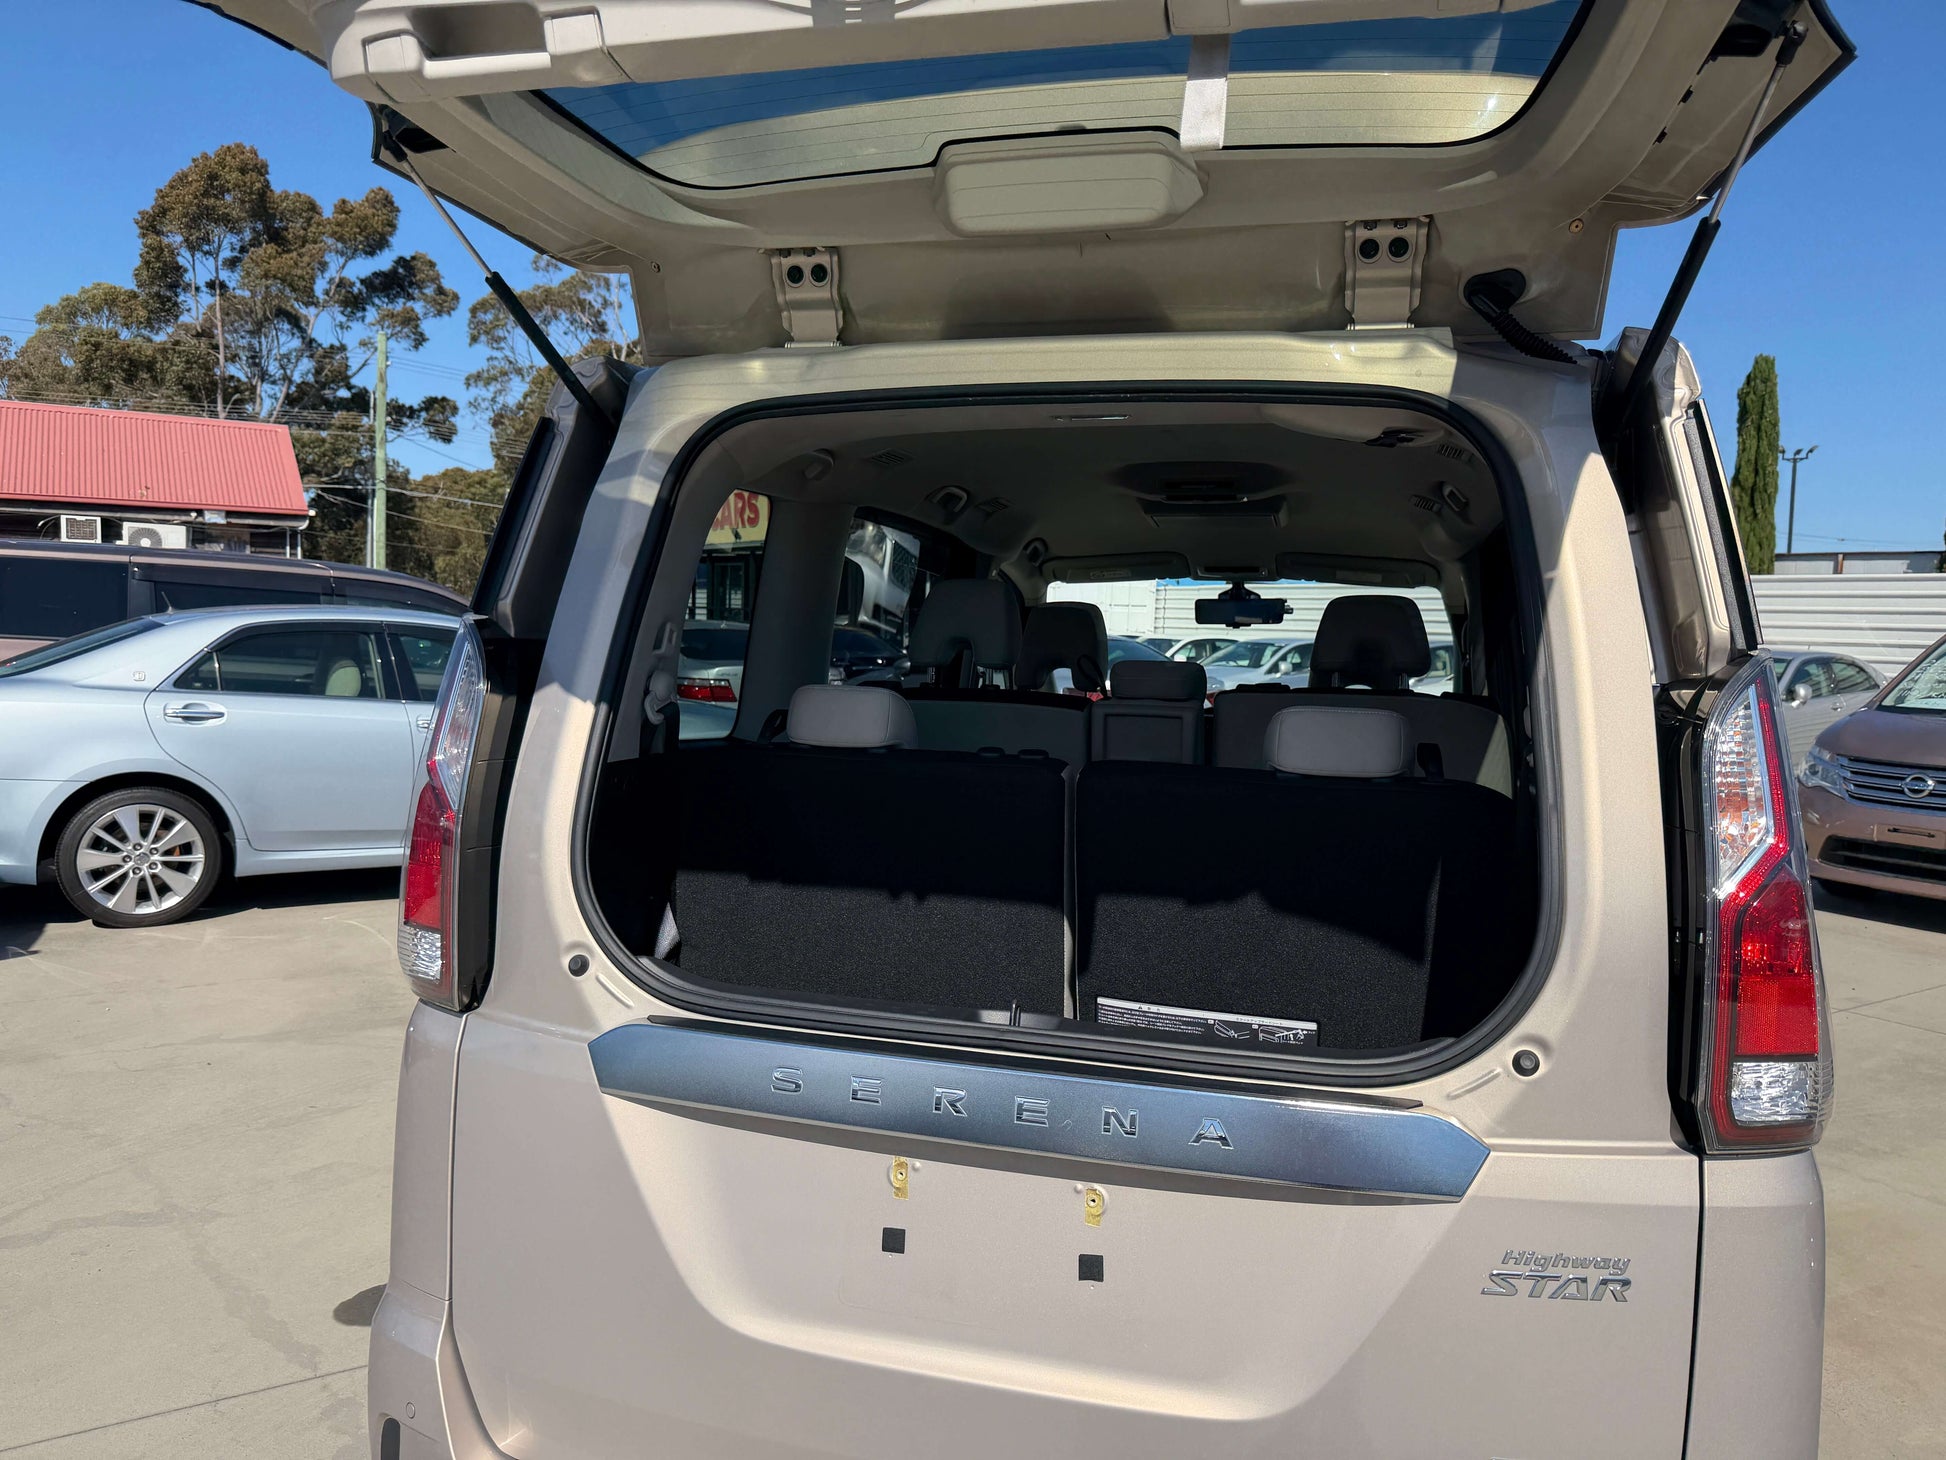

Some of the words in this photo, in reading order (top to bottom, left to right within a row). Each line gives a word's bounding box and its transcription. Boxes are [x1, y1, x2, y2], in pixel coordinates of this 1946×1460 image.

[711, 492, 760, 531] ARS
[771, 1067, 1234, 1150] SERENA
[1501, 1250, 1631, 1276] Highway
[1480, 1270, 1632, 1302] STAR
